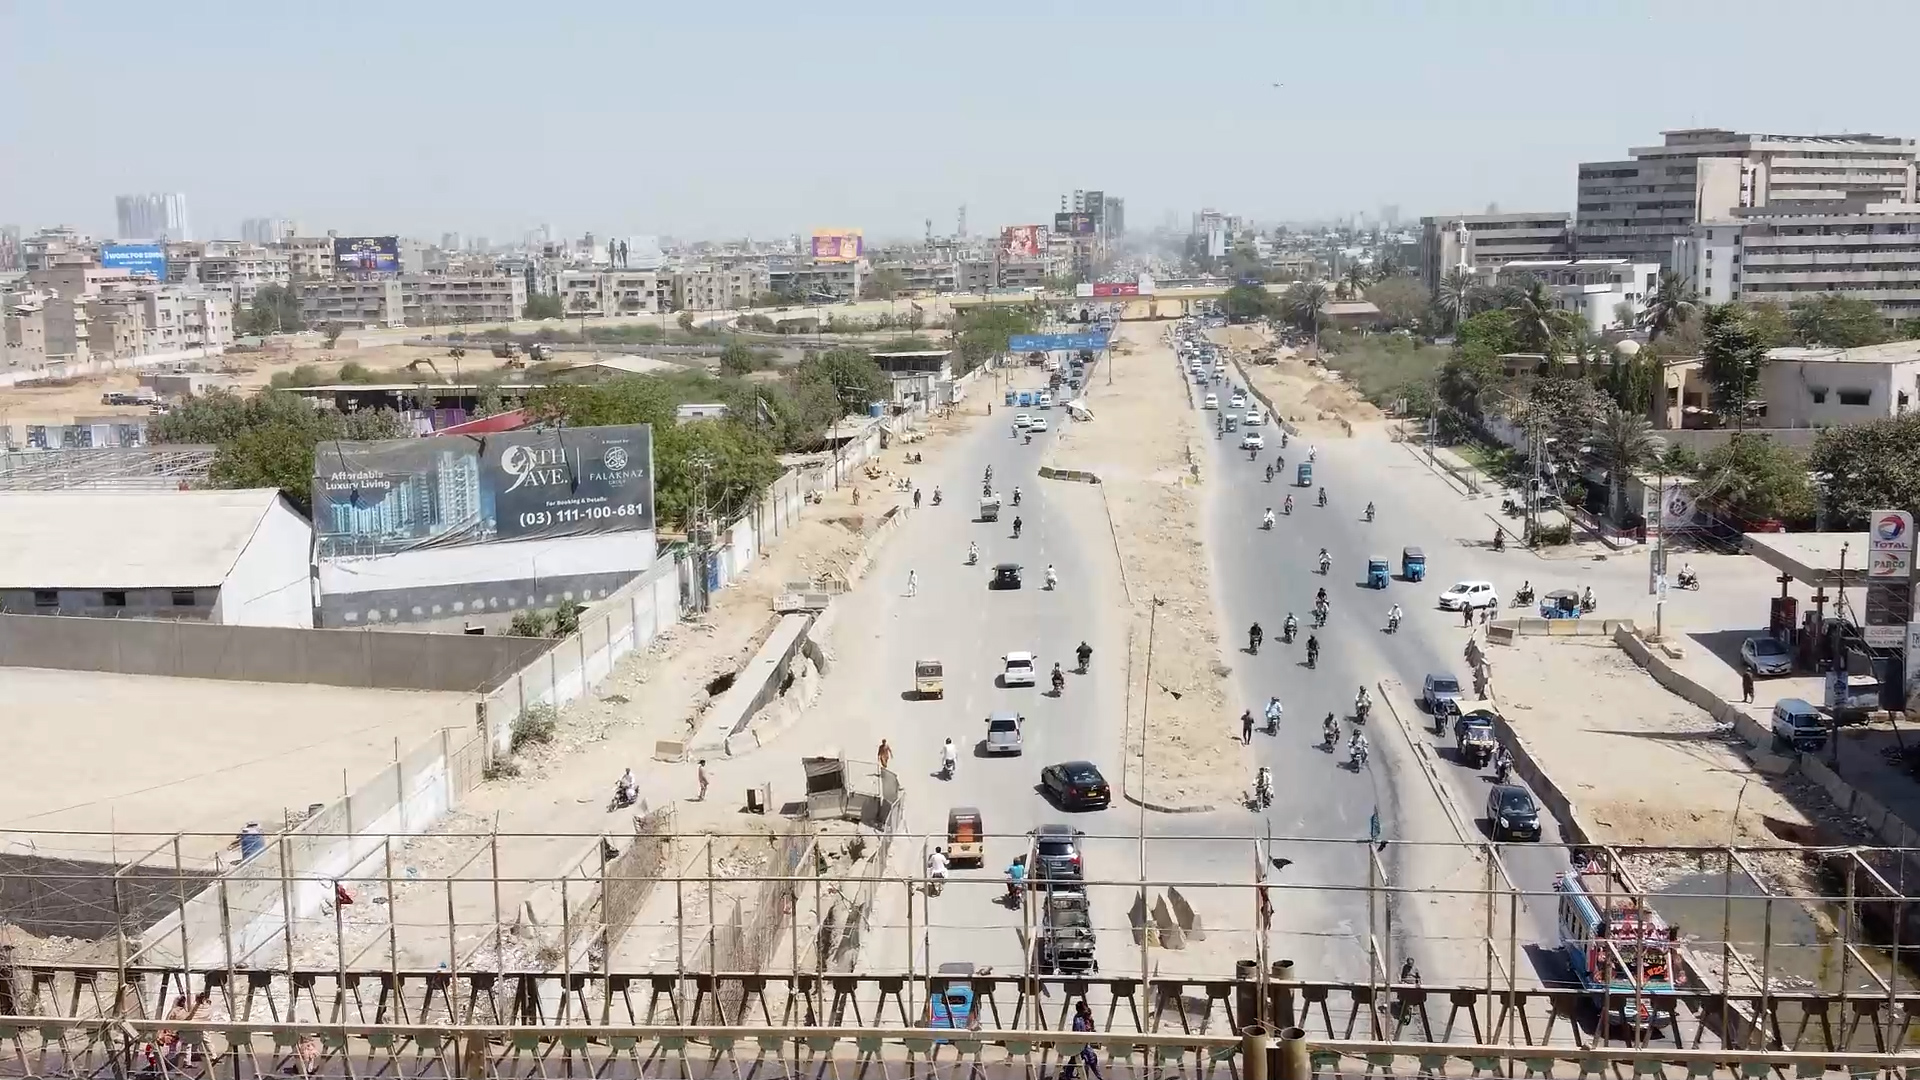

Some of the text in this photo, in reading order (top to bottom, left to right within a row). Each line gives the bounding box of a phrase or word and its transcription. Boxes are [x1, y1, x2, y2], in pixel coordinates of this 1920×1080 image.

[331, 470, 384, 481] Affordable
[524, 468, 569, 487] AVE.
[589, 469, 644, 481] FALAKNAZ
[325, 479, 391, 490] Luxury Living
[519, 503, 643, 528] (03) 111-100-681
[1873, 540, 1909, 549] TOTAL
[1874, 560, 1905, 569] PARCO
